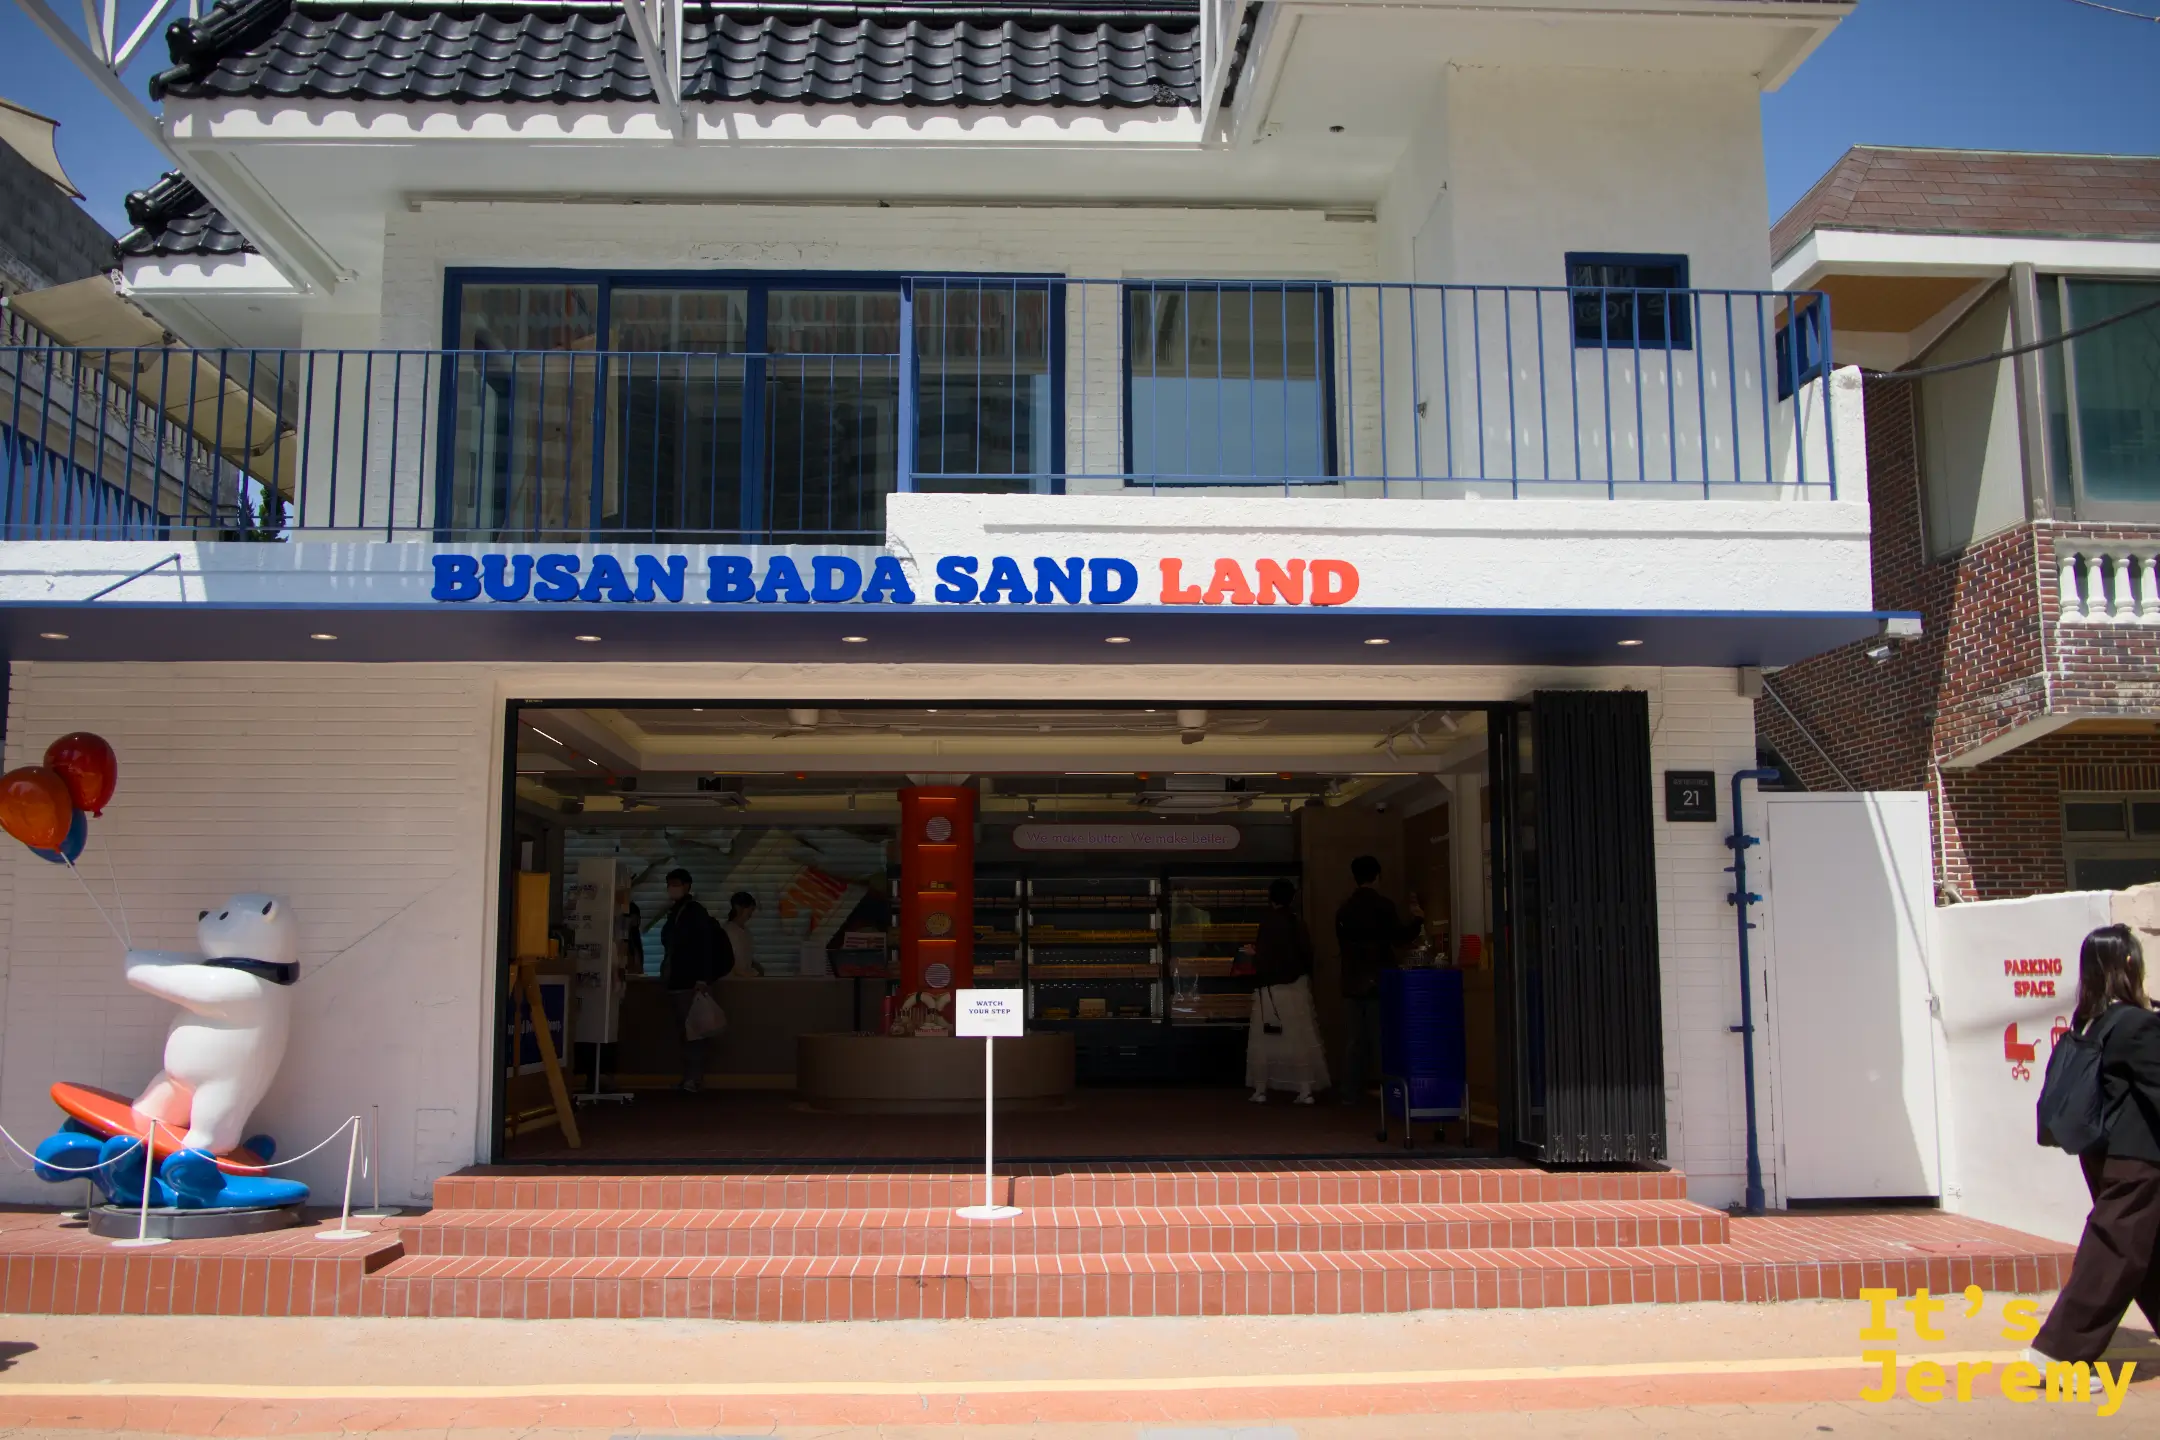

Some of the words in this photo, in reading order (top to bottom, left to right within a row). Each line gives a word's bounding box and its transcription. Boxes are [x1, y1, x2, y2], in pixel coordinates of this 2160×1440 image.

[430, 553, 688, 602] BUSAN
[706, 555, 916, 603] BADA
[935, 555, 1139, 604] SAND
[1159, 557, 1360, 606] LAND
[1682, 789, 1700, 806] 21
[1026, 831, 1048, 844] We
[1052, 831, 1085, 844] make
[1129, 831, 1152, 845] We
[1155, 831, 1188, 844] make
[2004, 957, 2063, 977] PARKING
[2014, 980, 2056, 998] SPACE
